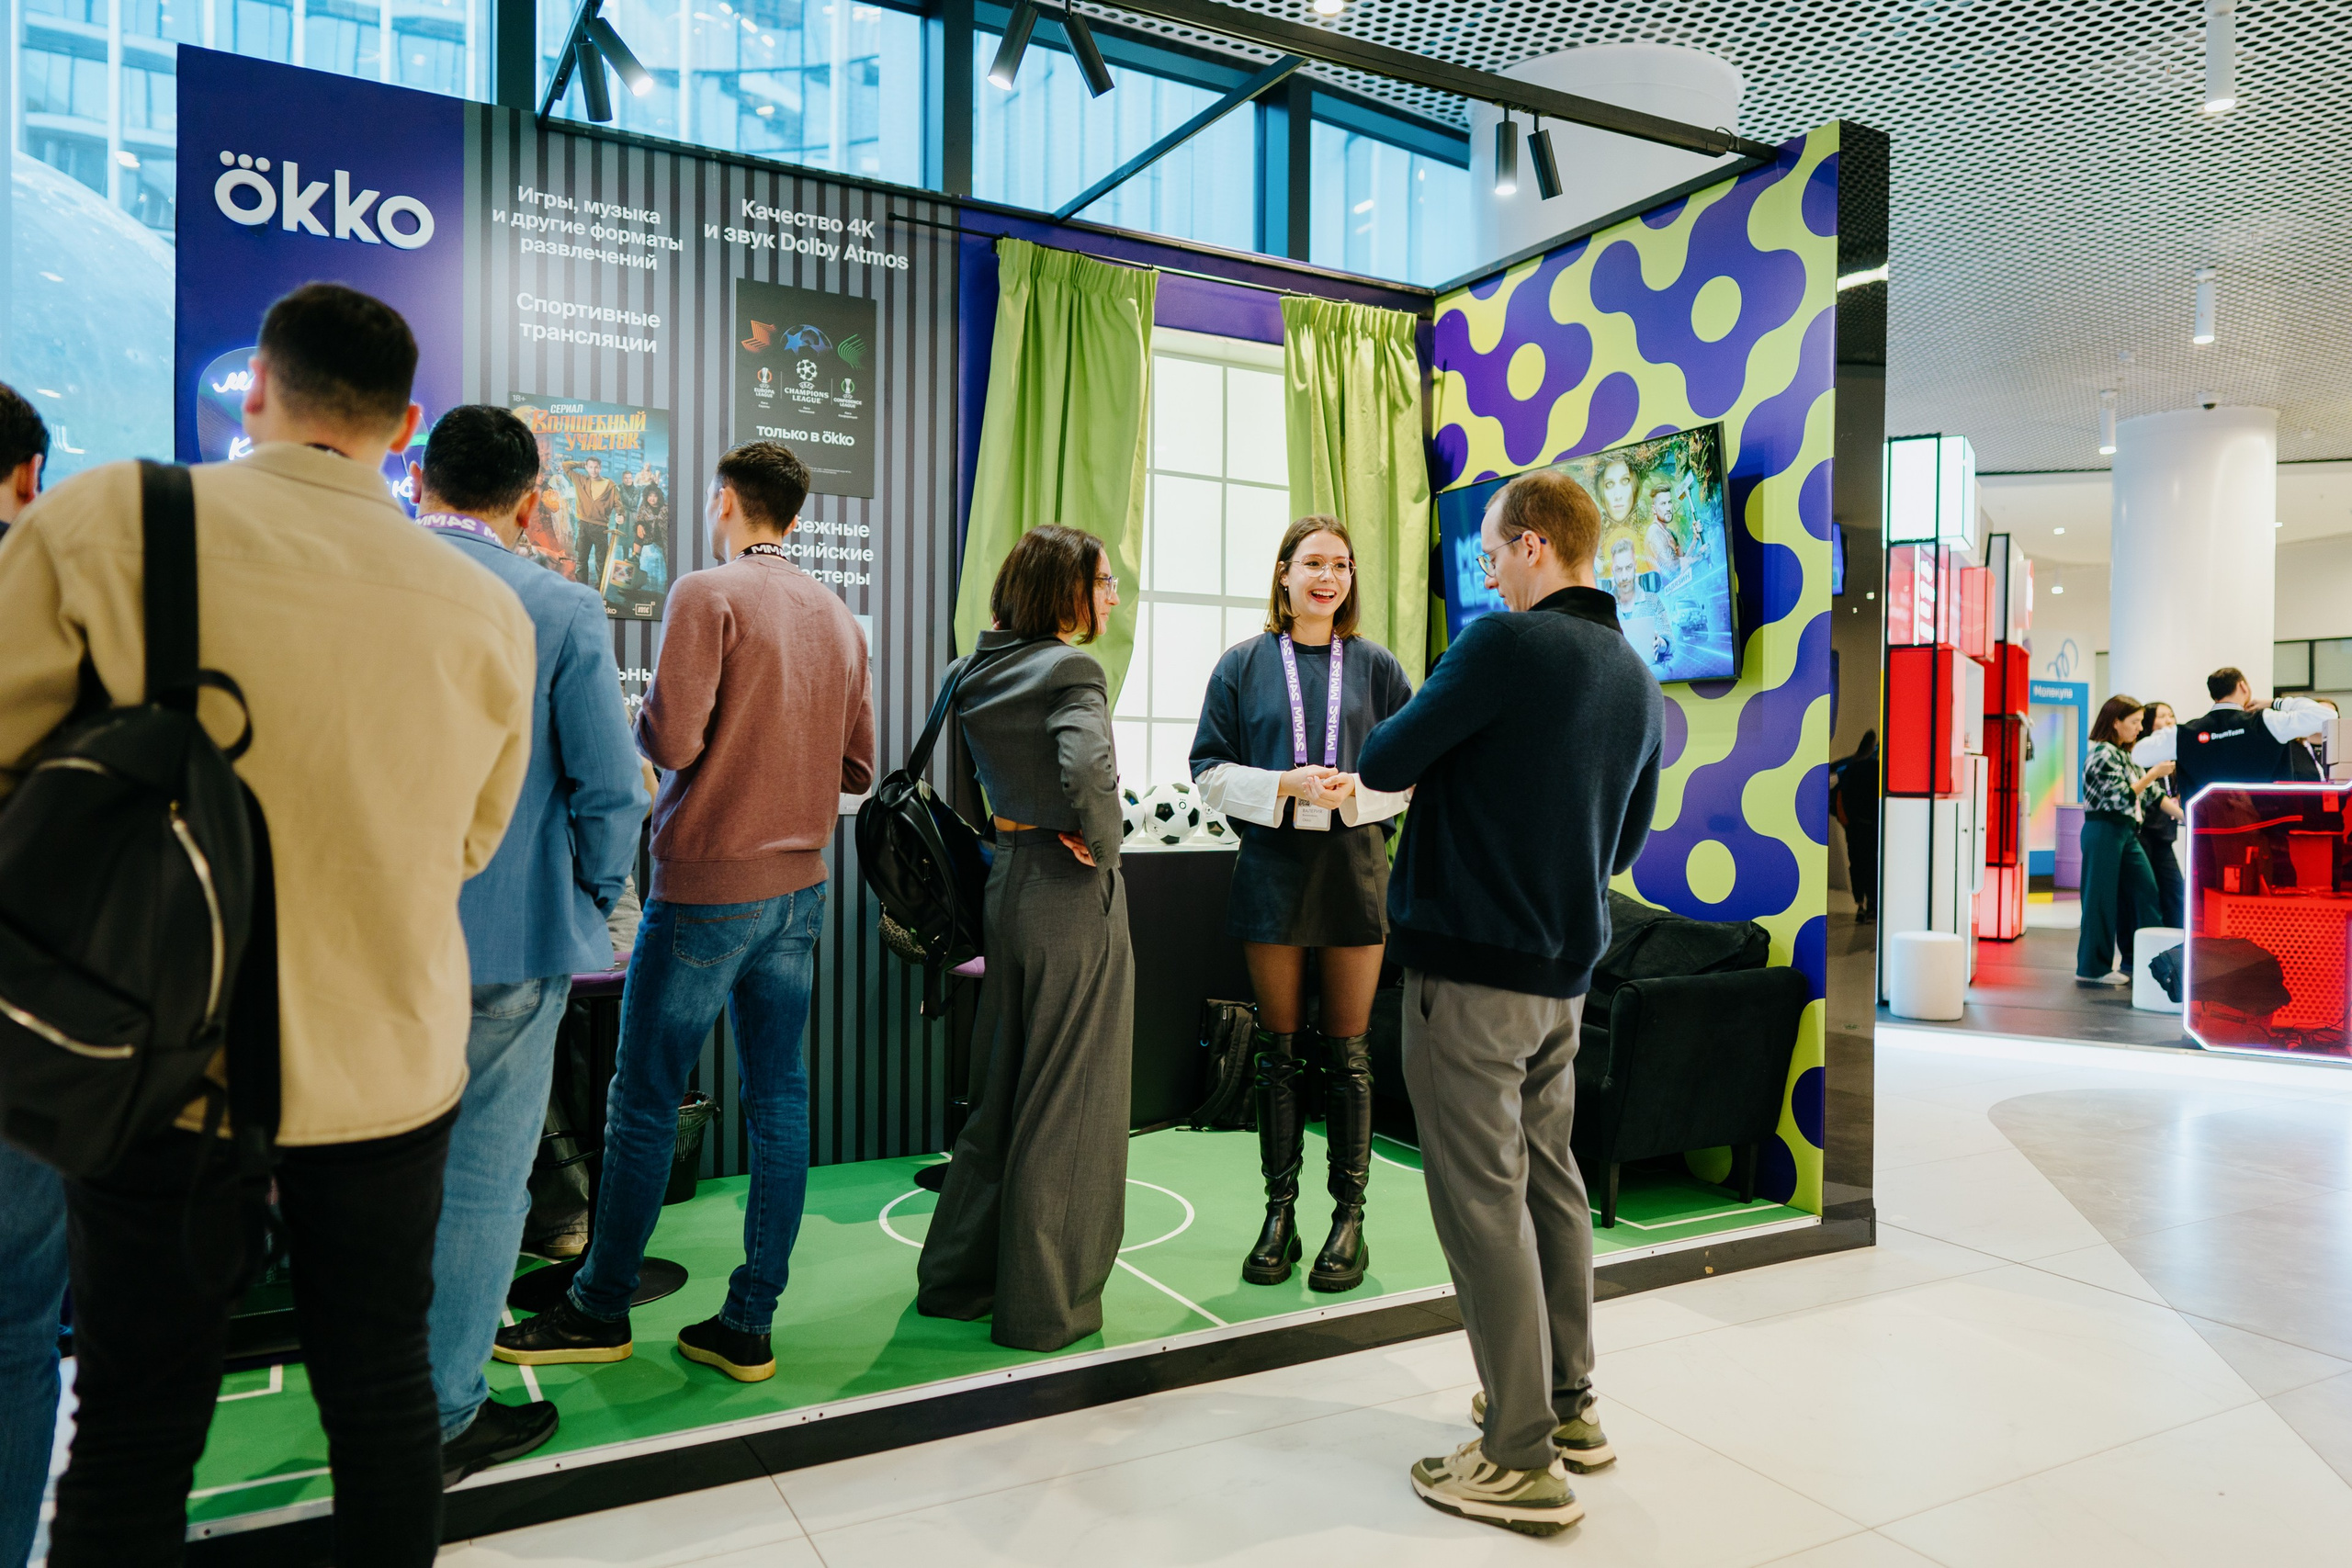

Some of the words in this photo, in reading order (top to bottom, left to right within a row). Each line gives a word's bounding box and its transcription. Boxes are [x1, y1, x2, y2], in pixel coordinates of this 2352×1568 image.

[214, 150, 435, 250] ökko
[517, 185, 579, 214] Игры,
[583, 199, 661, 224] музыка
[741, 198, 843, 233] Качество
[847, 218, 876, 239] 4K
[492, 209, 506, 223] и
[510, 211, 586, 235] другие
[590, 221, 684, 252] форматы
[520, 237, 658, 270] развлечений
[704, 223, 718, 240] и
[723, 227, 775, 249] звук
[780, 231, 840, 262] Dolby
[843, 243, 910, 270] Atmos
[516, 292, 662, 328] Спортивные
[519, 322, 658, 354] трансляции
[513, 394, 526, 402] 18+
[753, 387, 775, 395] EUROPA
[784, 387, 830, 399] CHAMPIONS
[792, 395, 821, 404] LEAGUE
[833, 397, 862, 405] CONFERENCE
[550, 404, 584, 413] СЕРИАЛ
[564, 432, 639, 451] УЧАСТОК
[756, 425, 808, 441] только
[810, 432, 820, 442] в
[792, 515, 870, 538] бежные
[782, 542, 874, 562] ссийские
[801, 568, 871, 588] стеры
[616, 667, 656, 681] ьны
